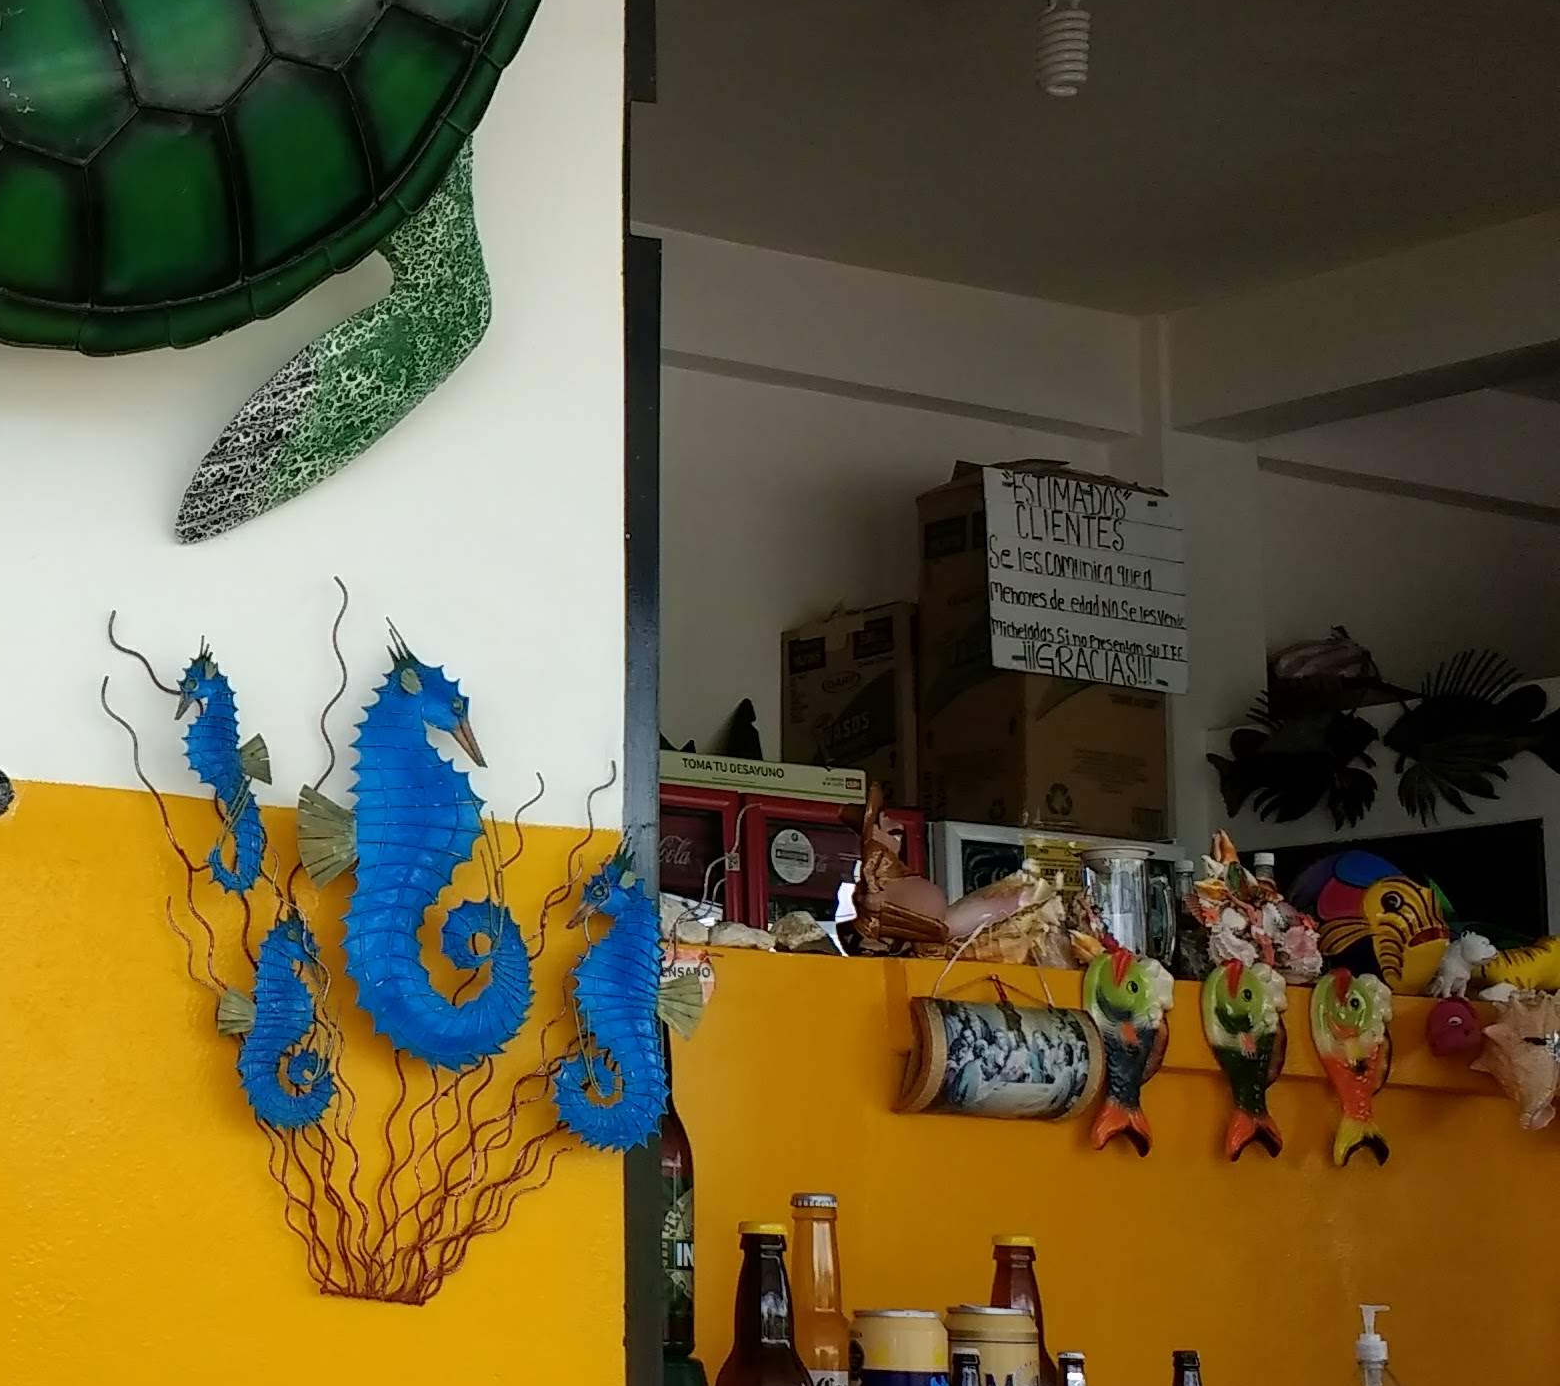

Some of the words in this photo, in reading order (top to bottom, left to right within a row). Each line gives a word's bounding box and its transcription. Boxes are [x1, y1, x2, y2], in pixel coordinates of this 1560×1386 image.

[1016, 504, 1125, 552] CLIENTES
[989, 534, 1014, 569] Se
[1017, 546, 1043, 575] les
[1049, 588, 1066, 611] de
[682, 757, 713, 771] TOMA
[714, 761, 728, 773] TU
[729, 763, 785, 779] DESAYUNO
